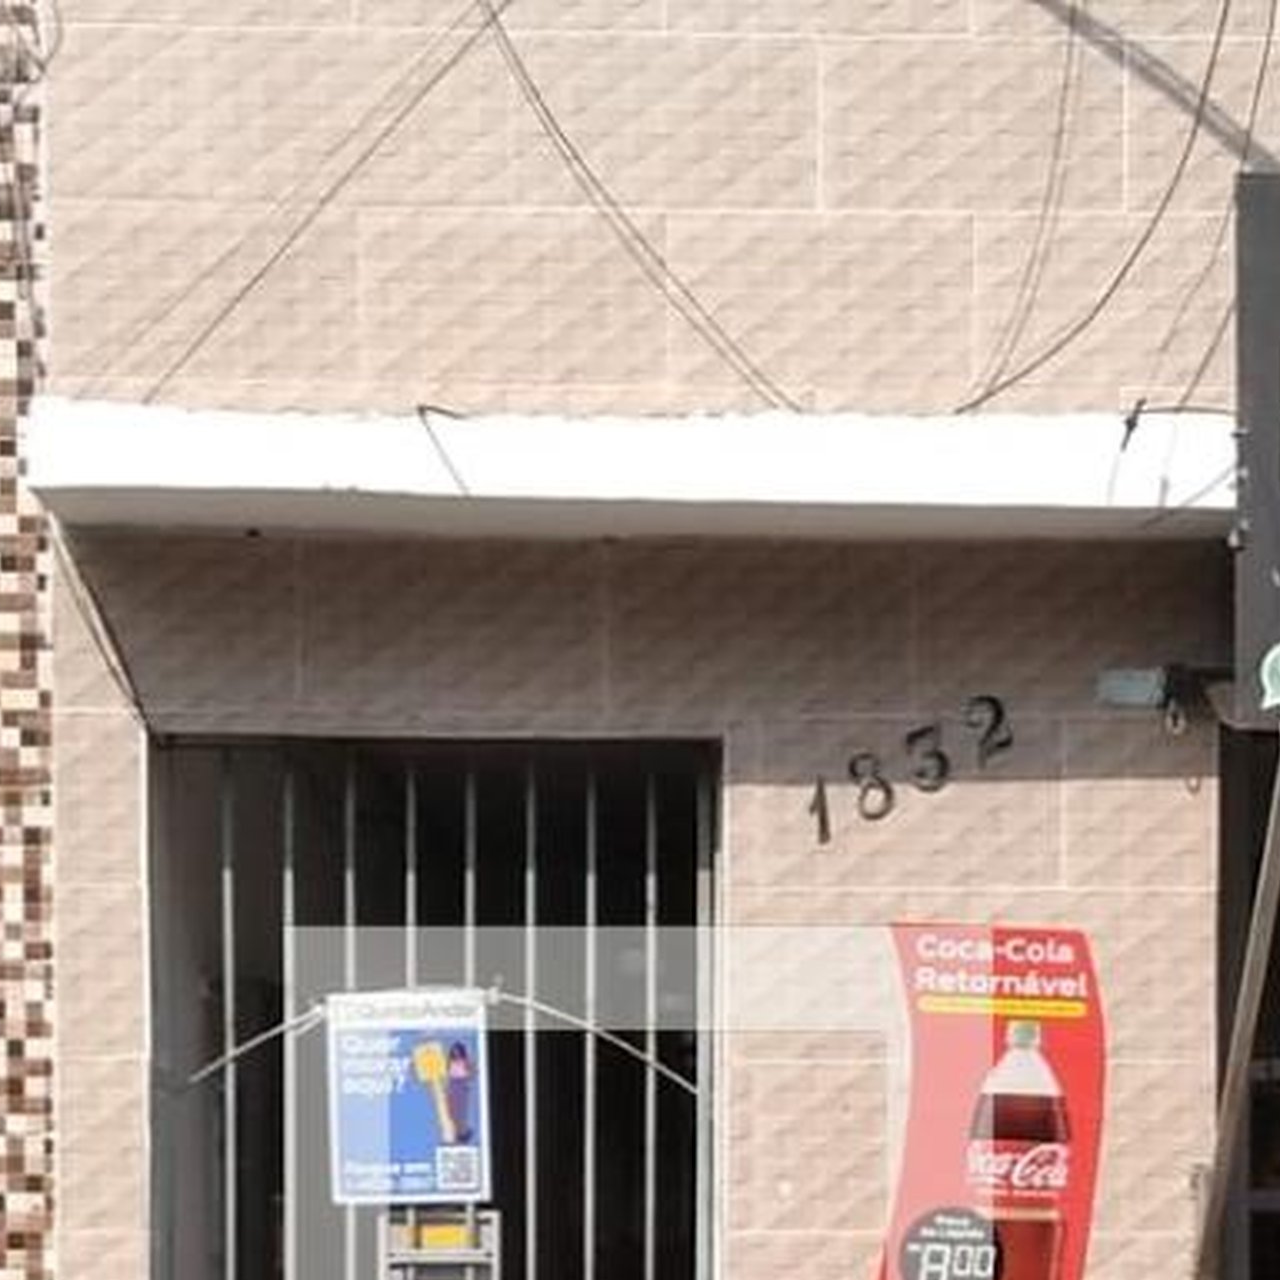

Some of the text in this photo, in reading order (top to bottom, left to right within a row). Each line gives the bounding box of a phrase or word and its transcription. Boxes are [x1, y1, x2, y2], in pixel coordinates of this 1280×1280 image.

[809, 695, 1013, 844] 1832
[916, 934, 1075, 964] Coca-Cola
[916, 965, 1088, 998] Retornável
